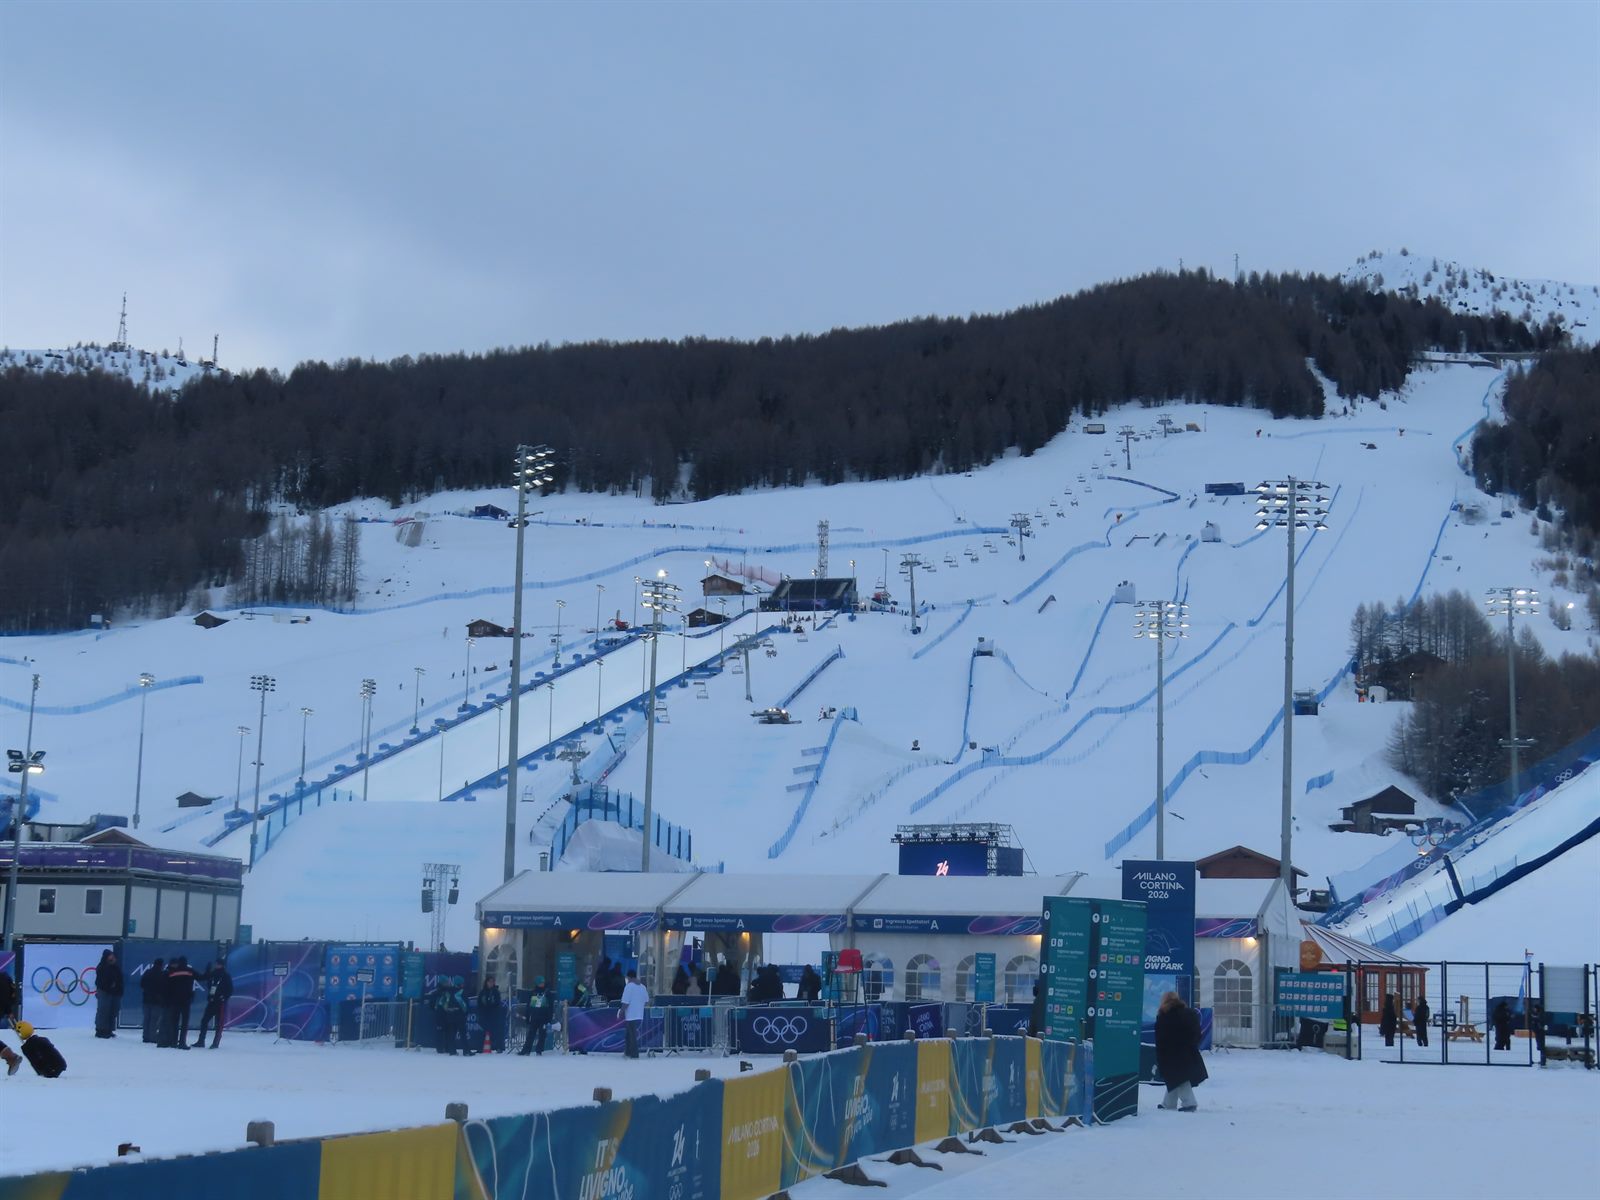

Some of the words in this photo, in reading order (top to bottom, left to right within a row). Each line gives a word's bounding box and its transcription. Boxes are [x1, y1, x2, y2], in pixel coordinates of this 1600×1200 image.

[1132, 872, 1177, 881] MILANO
[1139, 881, 1185, 890] CORTINA
[1147, 890, 1169, 899] 2026
[554, 916, 562, 926] A
[736, 918, 745, 929] A
[930, 919, 939, 930] A
[595, 1136, 619, 1168] IT'S
